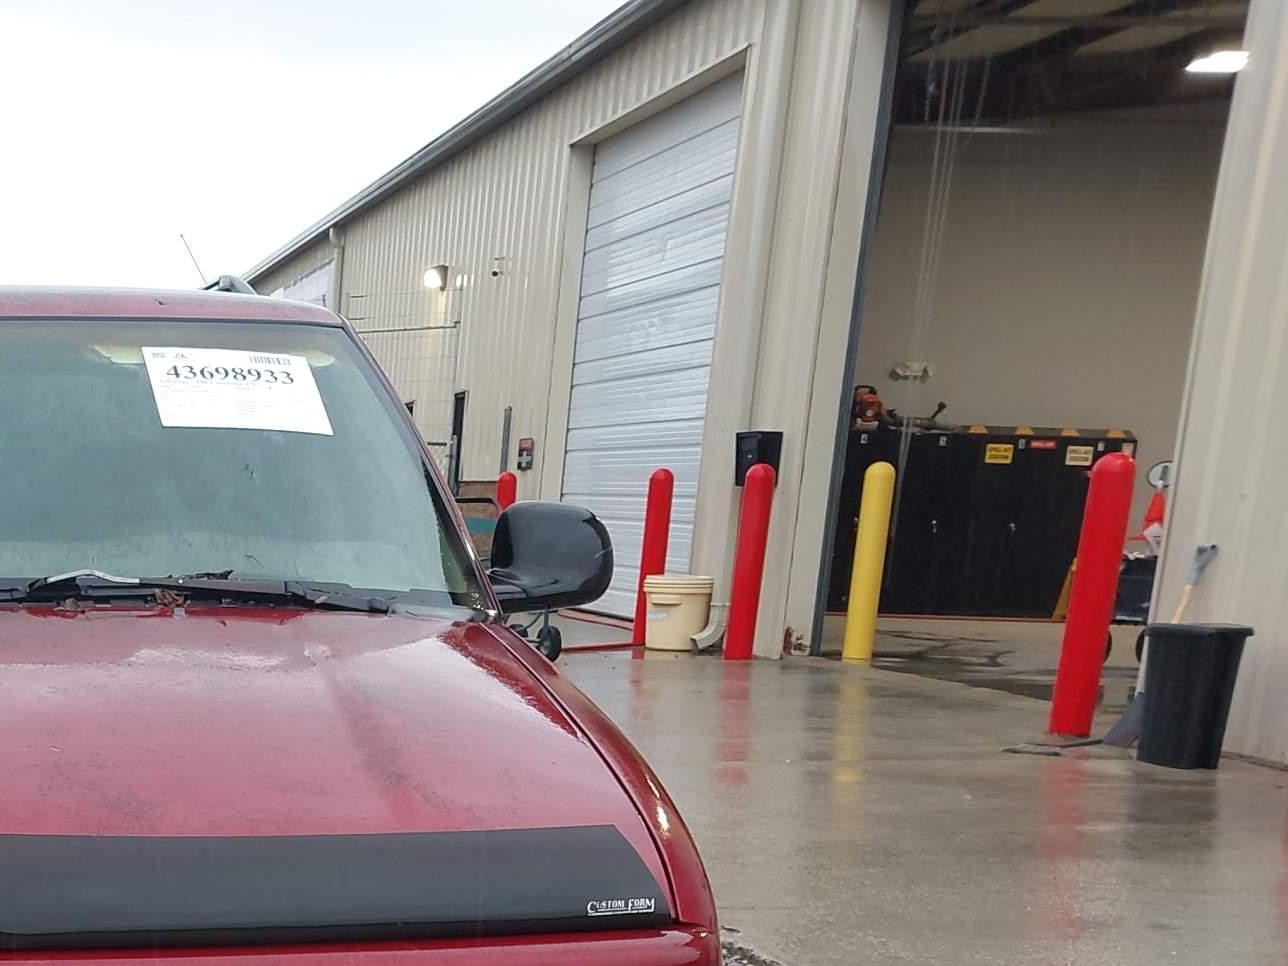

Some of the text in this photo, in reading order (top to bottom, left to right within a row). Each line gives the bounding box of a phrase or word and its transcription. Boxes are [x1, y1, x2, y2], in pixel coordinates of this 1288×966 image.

[166, 364, 294, 385] 43698933
[587, 897, 655, 913] CUSTOM FORM
